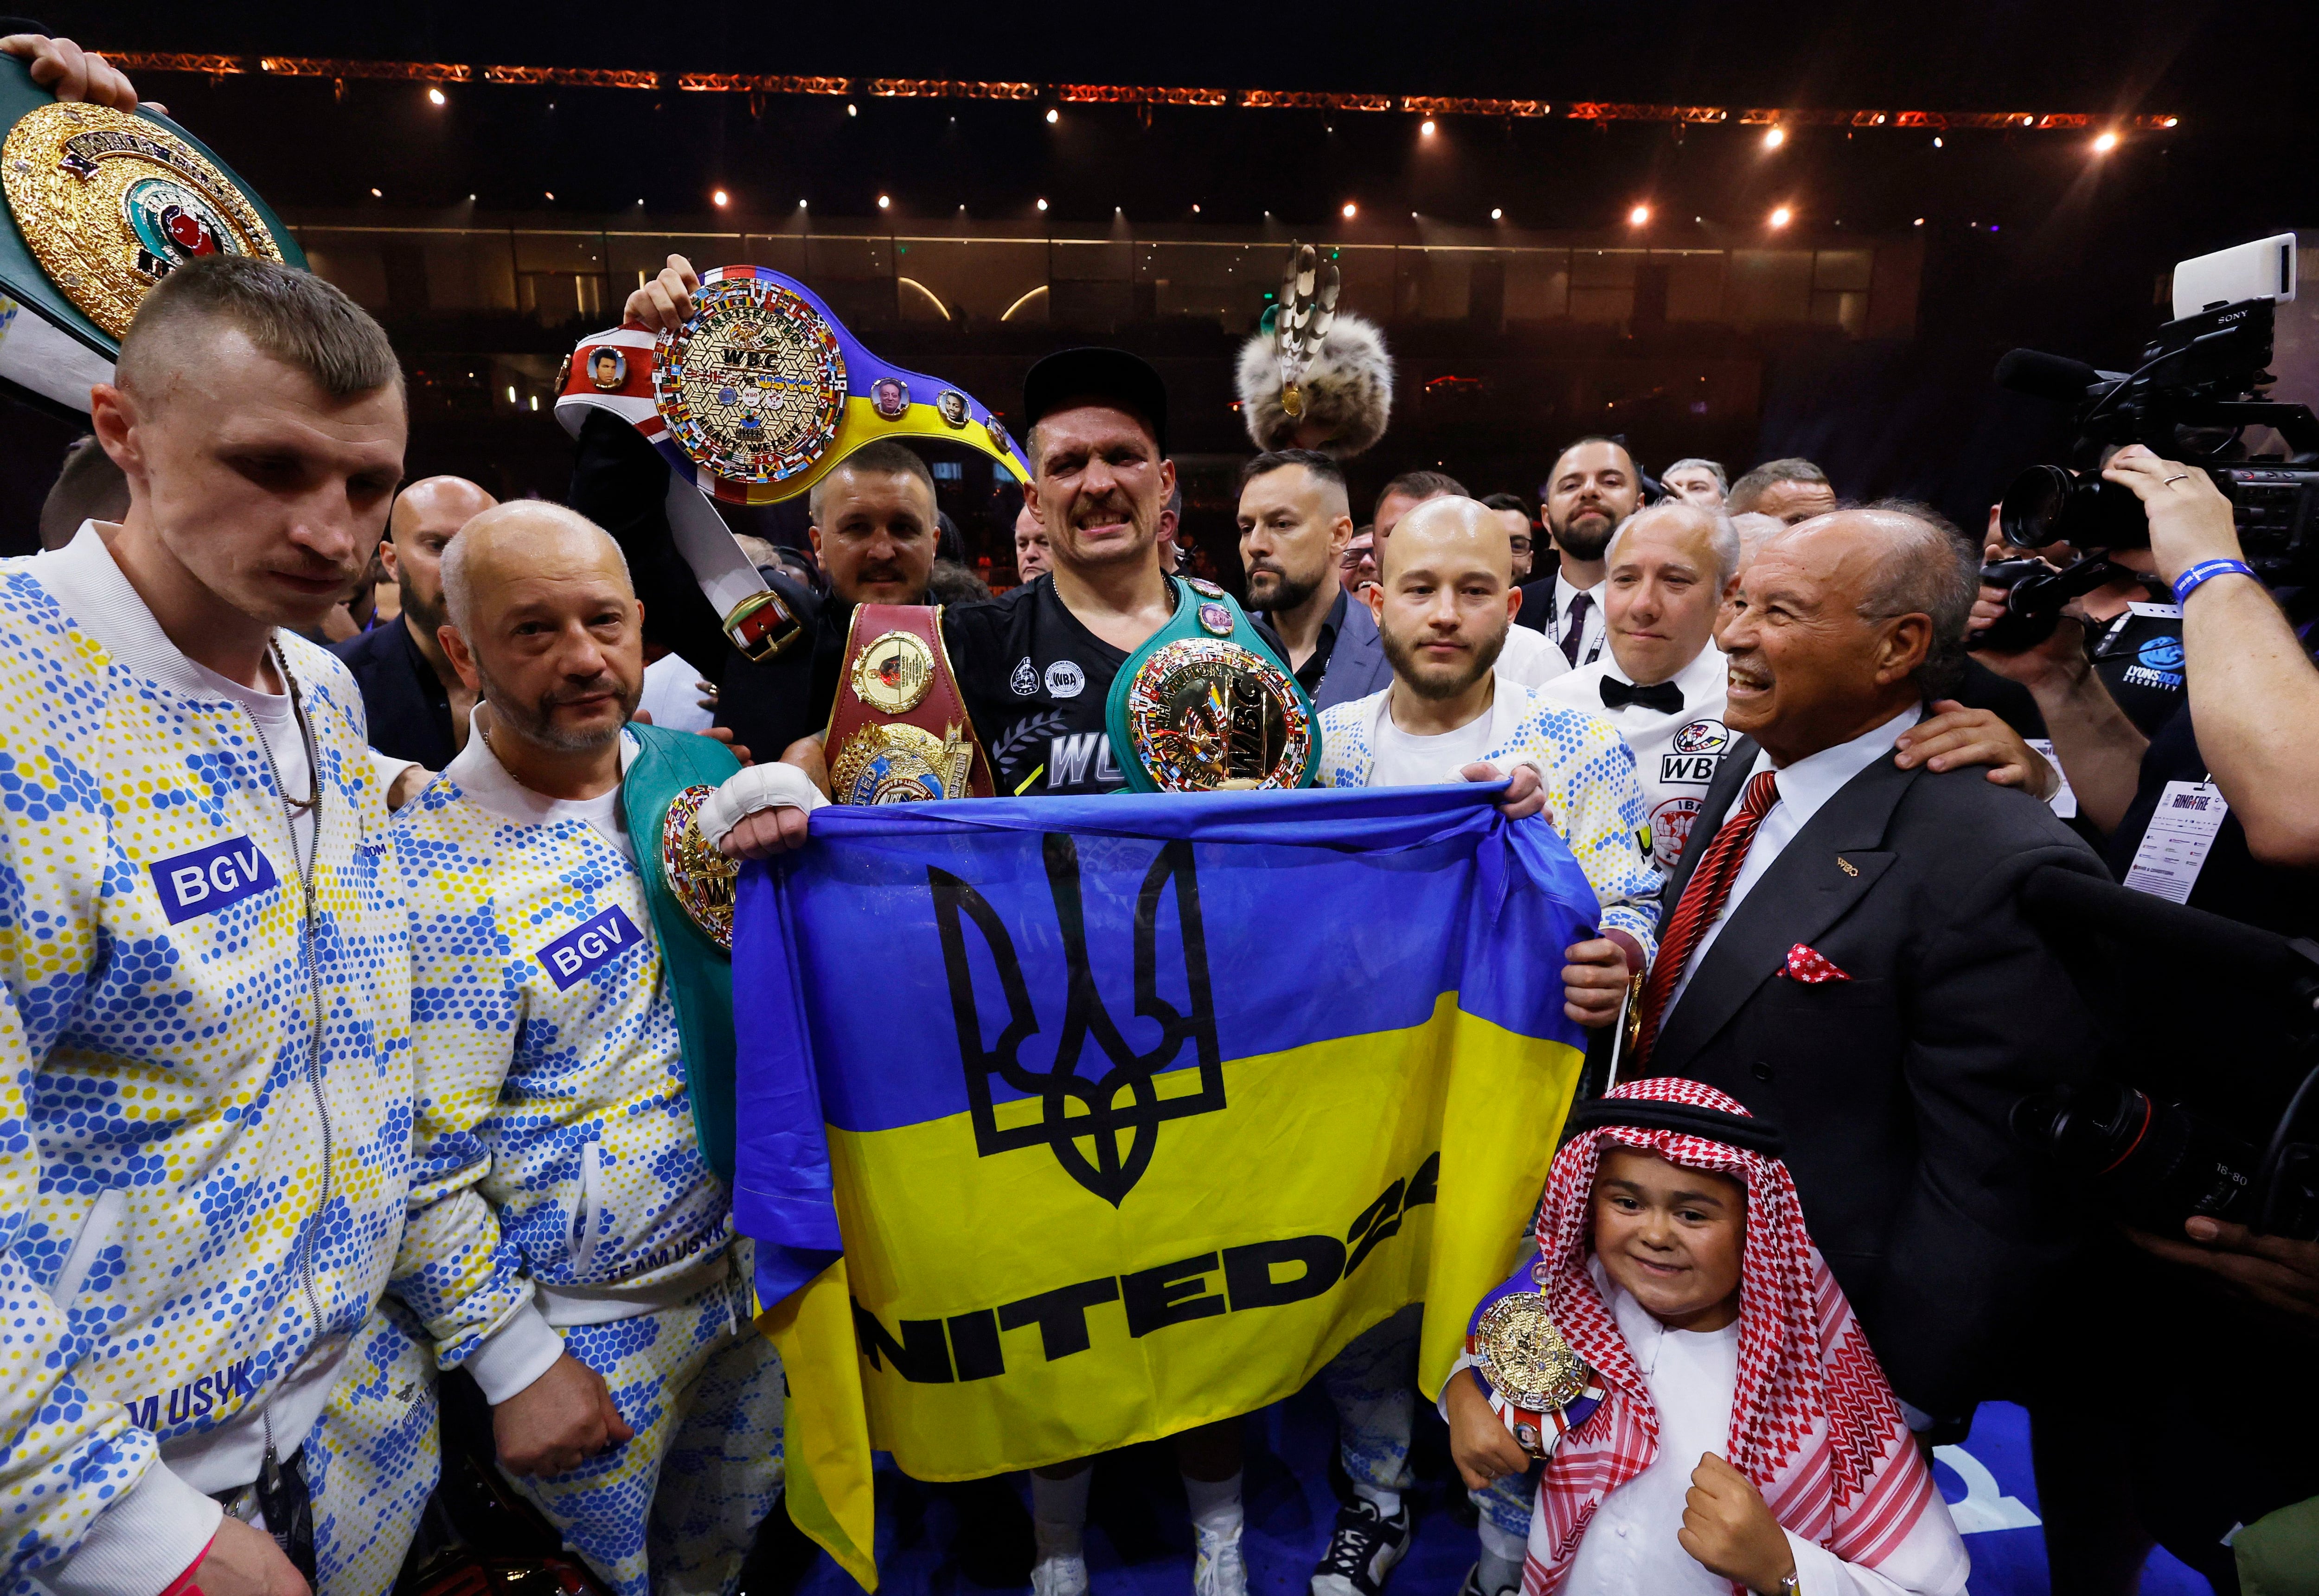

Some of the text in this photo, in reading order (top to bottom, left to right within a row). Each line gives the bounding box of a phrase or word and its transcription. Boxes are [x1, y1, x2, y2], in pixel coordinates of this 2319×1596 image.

[701, 308, 802, 345] UNDISPUTED
[2218, 310, 2249, 324] SONY
[723, 348, 778, 368] WBC
[759, 376, 812, 392] USYK
[1052, 661, 1065, 670] BOXING
[1065, 661, 1084, 679] ASSOCIATION
[1053, 672, 1077, 687] WBA
[2122, 675, 2178, 692] SECURITY
[1157, 663, 1223, 731] CHAMPION
[1228, 677, 1263, 780] WBC
[1664, 758, 1713, 779] WB
[904, 779, 928, 795] HONESTY
[171, 846, 259, 907] BGV
[551, 917, 622, 977] BGV
[605, 1210, 728, 1281] TEAM USYK
[1516, 1329, 1531, 1365] WBC
[168, 1356, 254, 1425] USYK
